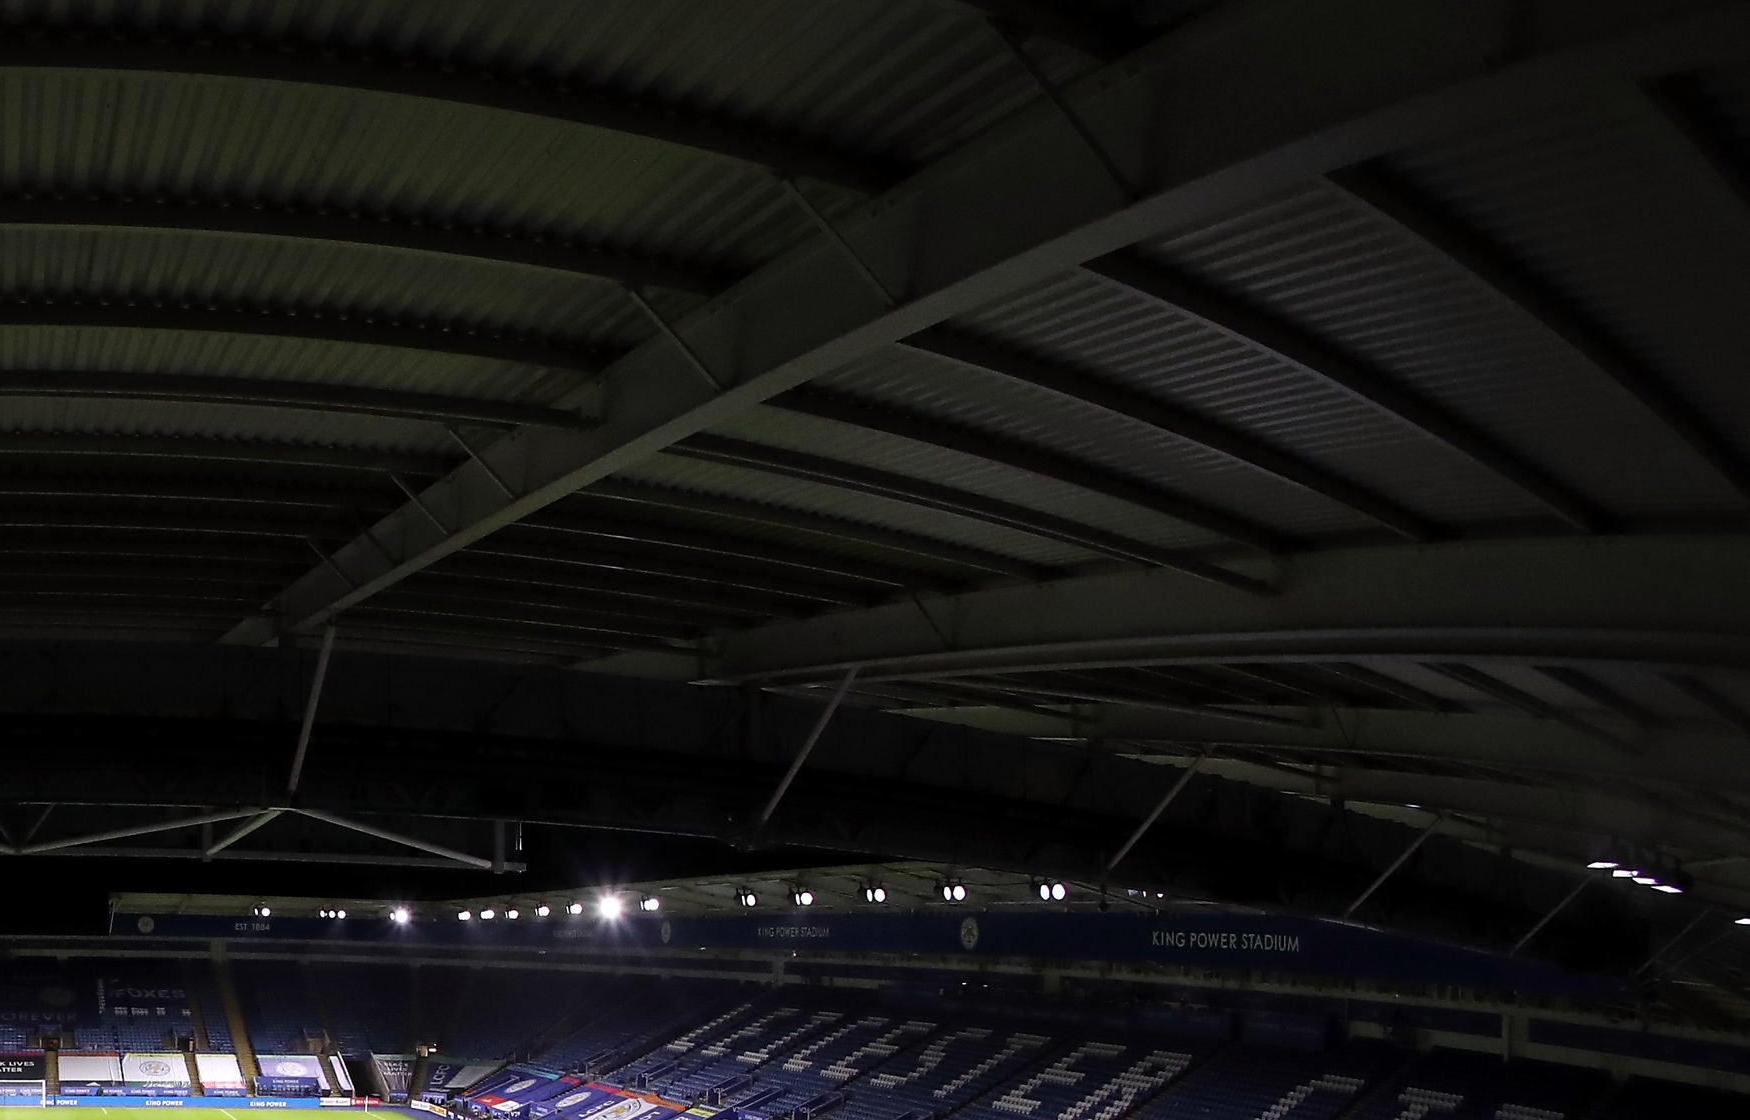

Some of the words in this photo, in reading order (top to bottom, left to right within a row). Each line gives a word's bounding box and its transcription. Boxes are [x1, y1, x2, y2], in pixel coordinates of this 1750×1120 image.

[1152, 930, 1186, 948] KING
[1190, 932, 1238, 950] POWER
[1241, 933, 1300, 953] STADIUM
